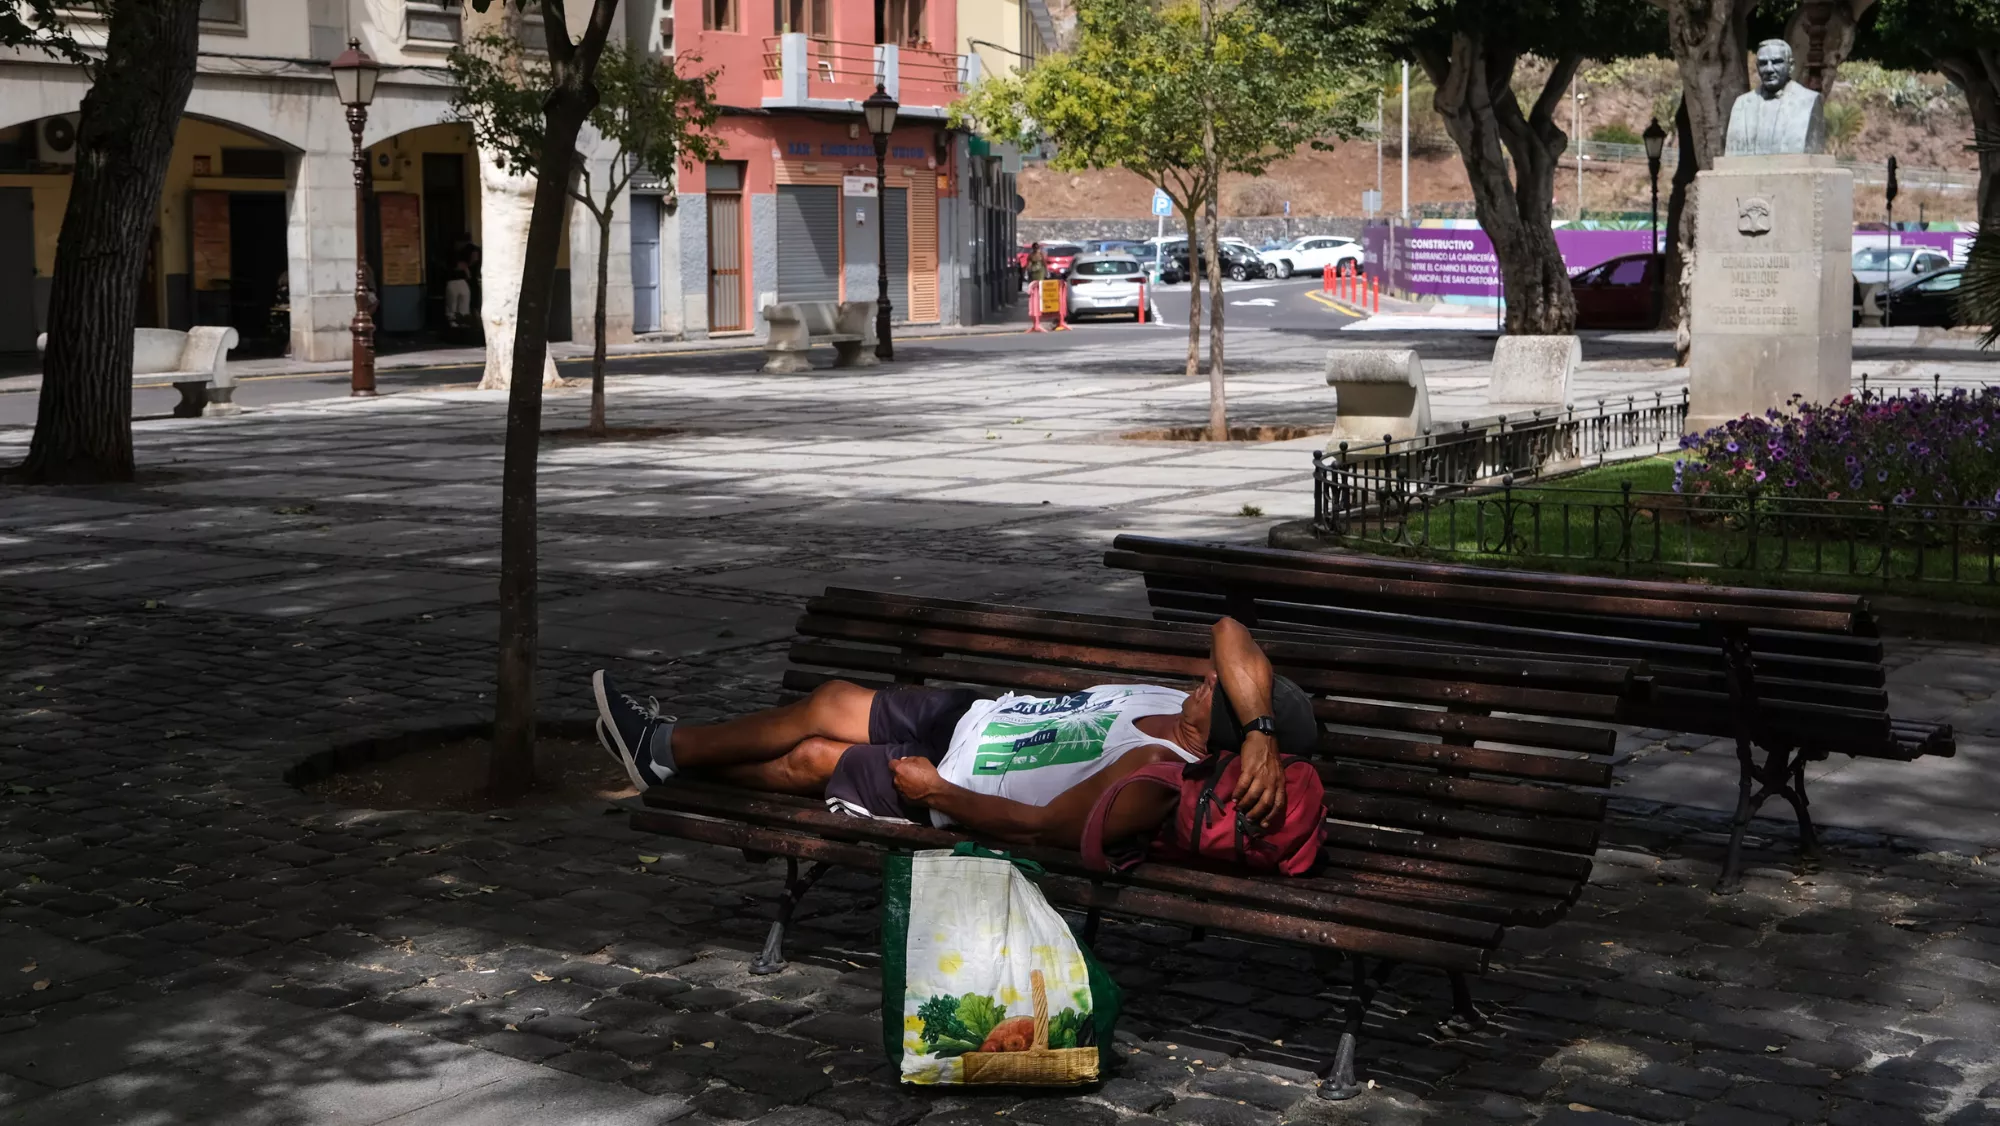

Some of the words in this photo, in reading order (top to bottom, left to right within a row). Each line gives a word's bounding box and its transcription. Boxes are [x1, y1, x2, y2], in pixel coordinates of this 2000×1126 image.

[1156, 198, 1168, 212] P
[1411, 239, 1474, 250] CONSTRUCTIVO
[1415, 252, 1448, 261] BARRANCO
[1449, 253, 1456, 261] LA
[1766, 255, 1790, 268] JUAN
[1411, 262, 1426, 271] NTRE
[1434, 263, 1460, 272] CAMINO
[1468, 264, 1489, 274] ROQUE
[1491, 264, 1497, 273] Y
[1443, 275, 1451, 284] DE
[1452, 275, 1465, 284] SAN
[1466, 275, 1499, 285] CRISTOBA
[1731, 270, 1779, 285] MANRIQUE
